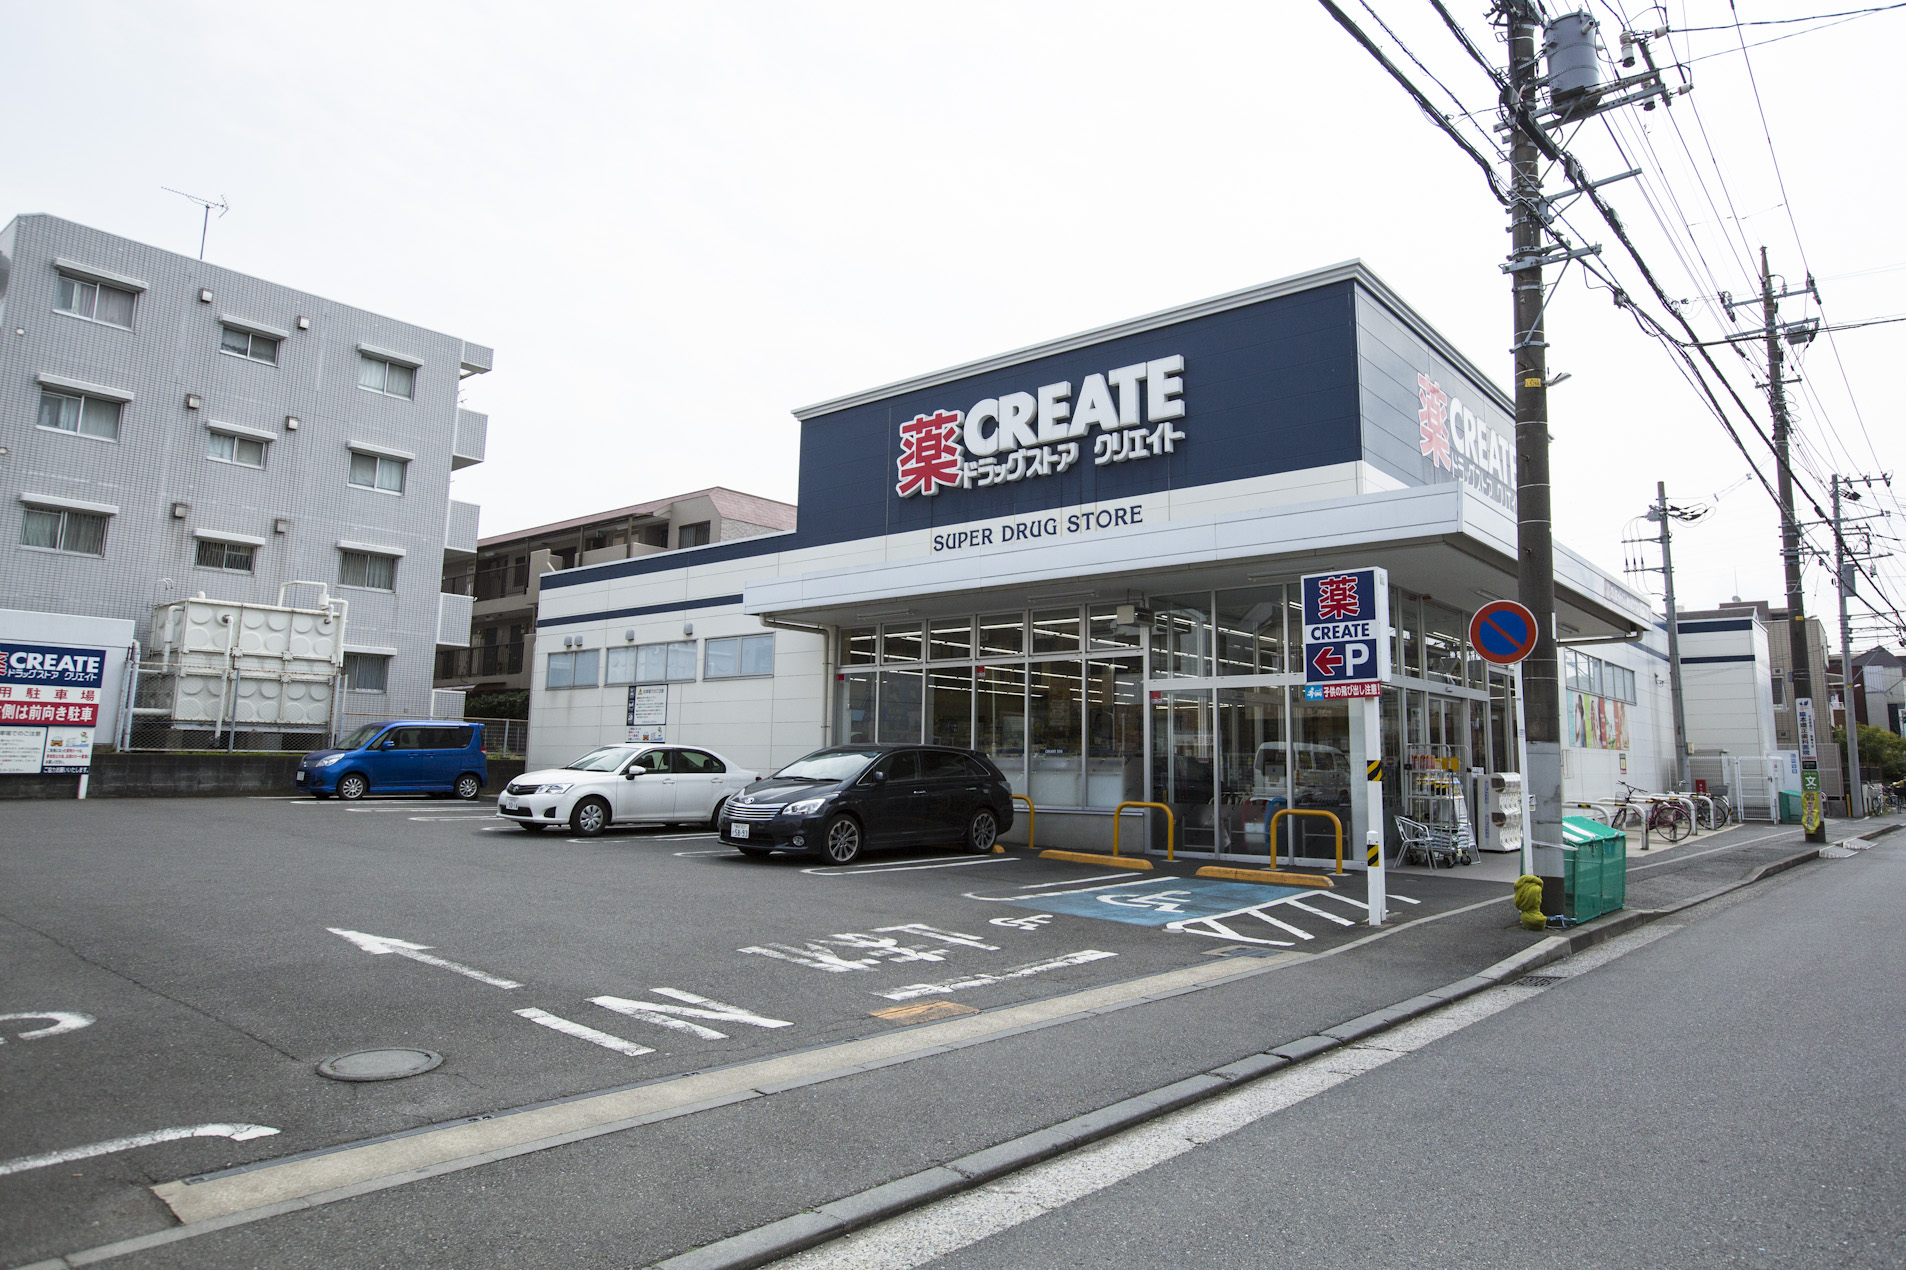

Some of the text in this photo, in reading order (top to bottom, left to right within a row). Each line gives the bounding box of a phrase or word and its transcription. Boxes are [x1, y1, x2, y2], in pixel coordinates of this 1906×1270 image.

[963, 354, 1185, 457] CREATE
[1418, 372, 1451, 472] 薬
[896, 408, 965, 498] 薬
[963, 421, 1186, 489] ドラッグストア クリエイト
[933, 504, 1144, 552] SUPER DRUG STORE
[1318, 575, 1360, 620] 薬
[1311, 622, 1370, 641] CREATE
[8, 668, 98, 682] ドラッグストア クリエイト
[9, 651, 101, 674] CREATE
[1344, 642, 1370, 677] P
[1323, 682, 1380, 698] 子供の飛び出し注意!
[0, 703, 94, 722] 側は前向き駐車
[1805, 776, 1817, 787] 文
[512, 986, 795, 1057] IN
